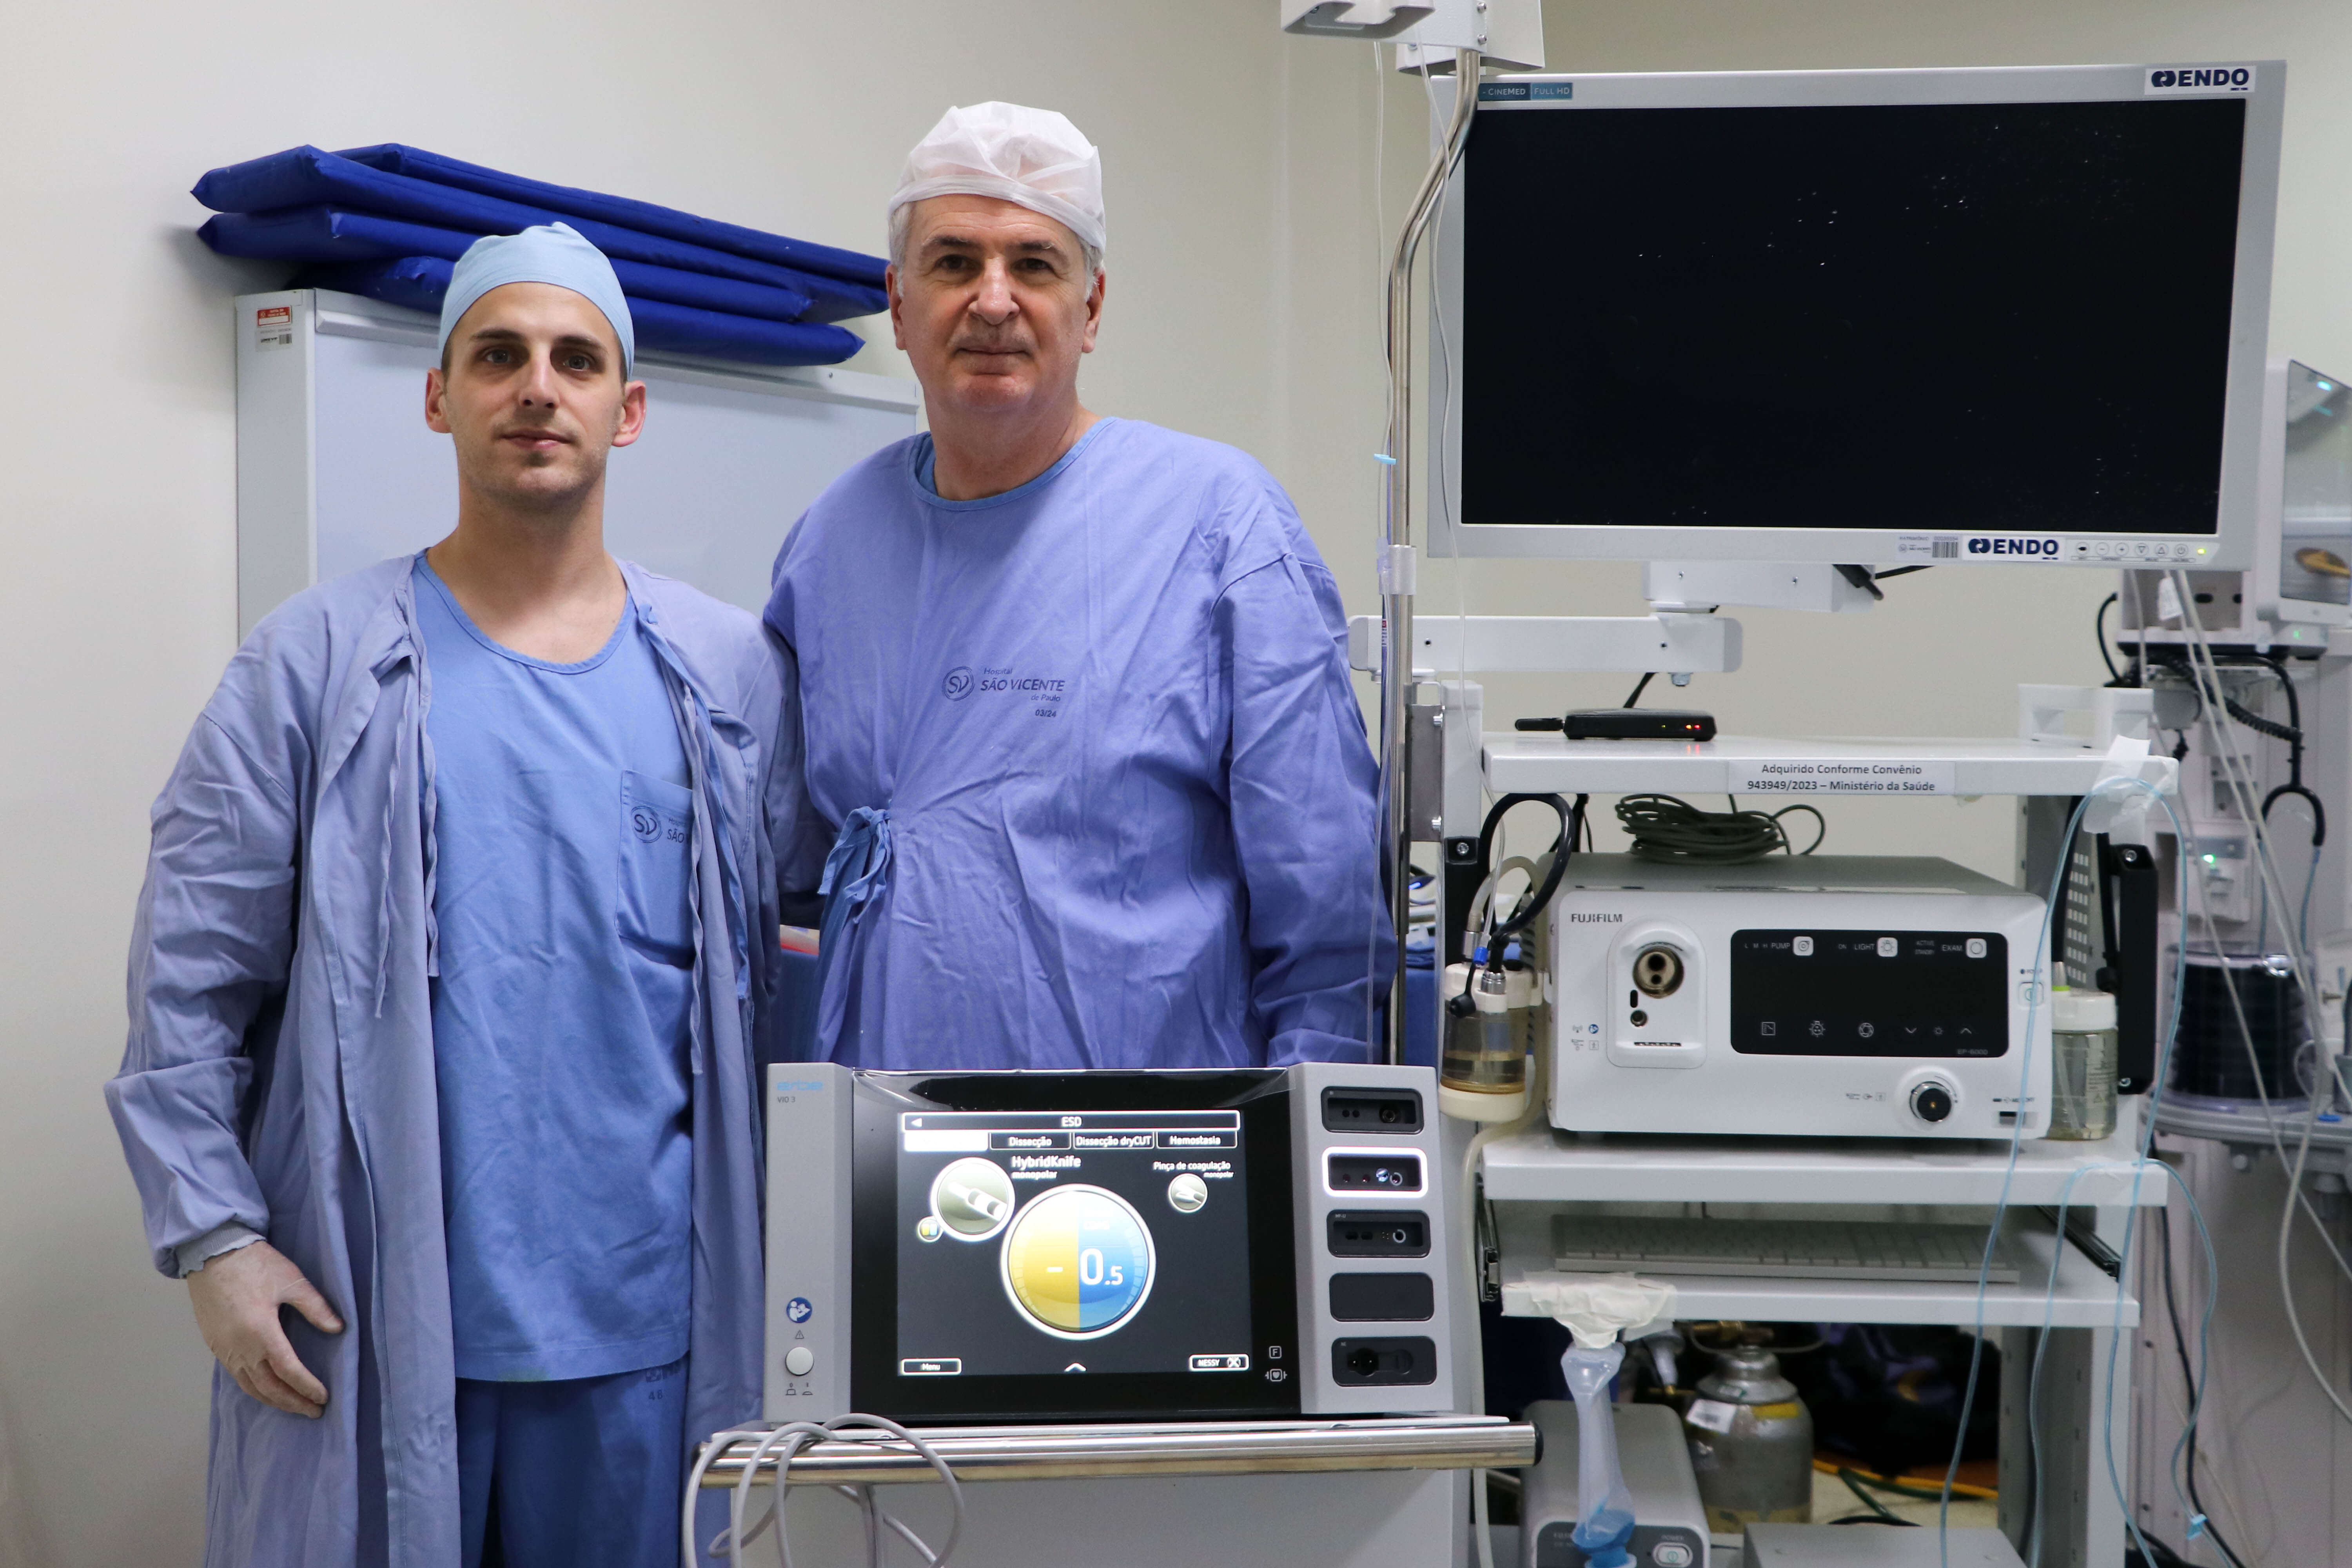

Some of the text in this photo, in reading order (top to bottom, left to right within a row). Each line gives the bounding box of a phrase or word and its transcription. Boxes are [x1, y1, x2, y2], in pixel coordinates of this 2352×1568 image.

[2178, 68, 2249, 86] ENDO
[1993, 539, 2059, 555] ENDO
[980, 678, 1065, 691] SÃO VICENTE
[1041, 693, 1061, 702] Paulo
[1035, 709, 1057, 718] 03/24
[1762, 764, 1922, 775] Adquirido Conforme Convênio
[1748, 780, 1818, 791] 943949/2023
[1829, 780, 1884, 791] Ministério
[1887, 781, 1900, 791] da
[1902, 781, 1935, 791] Saúde
[667, 828, 685, 843] SÃO
[1571, 913, 1623, 923] FUJIFILM
[1061, 1116, 1082, 1127] ESD
[1008, 1136, 1053, 1148] Dissecção
[1076, 1135, 1152, 1147] Dissecção dryCUT
[1169, 1135, 1221, 1145] Hemostasia
[1011, 1155, 1082, 1170] HybridKnife
[1153, 1160, 1231, 1172] Pinça de coagulação
[1011, 1170, 1058, 1180] monopolar
[922, 1363, 941, 1371] Menu
[1198, 1359, 1220, 1367] NESSY
